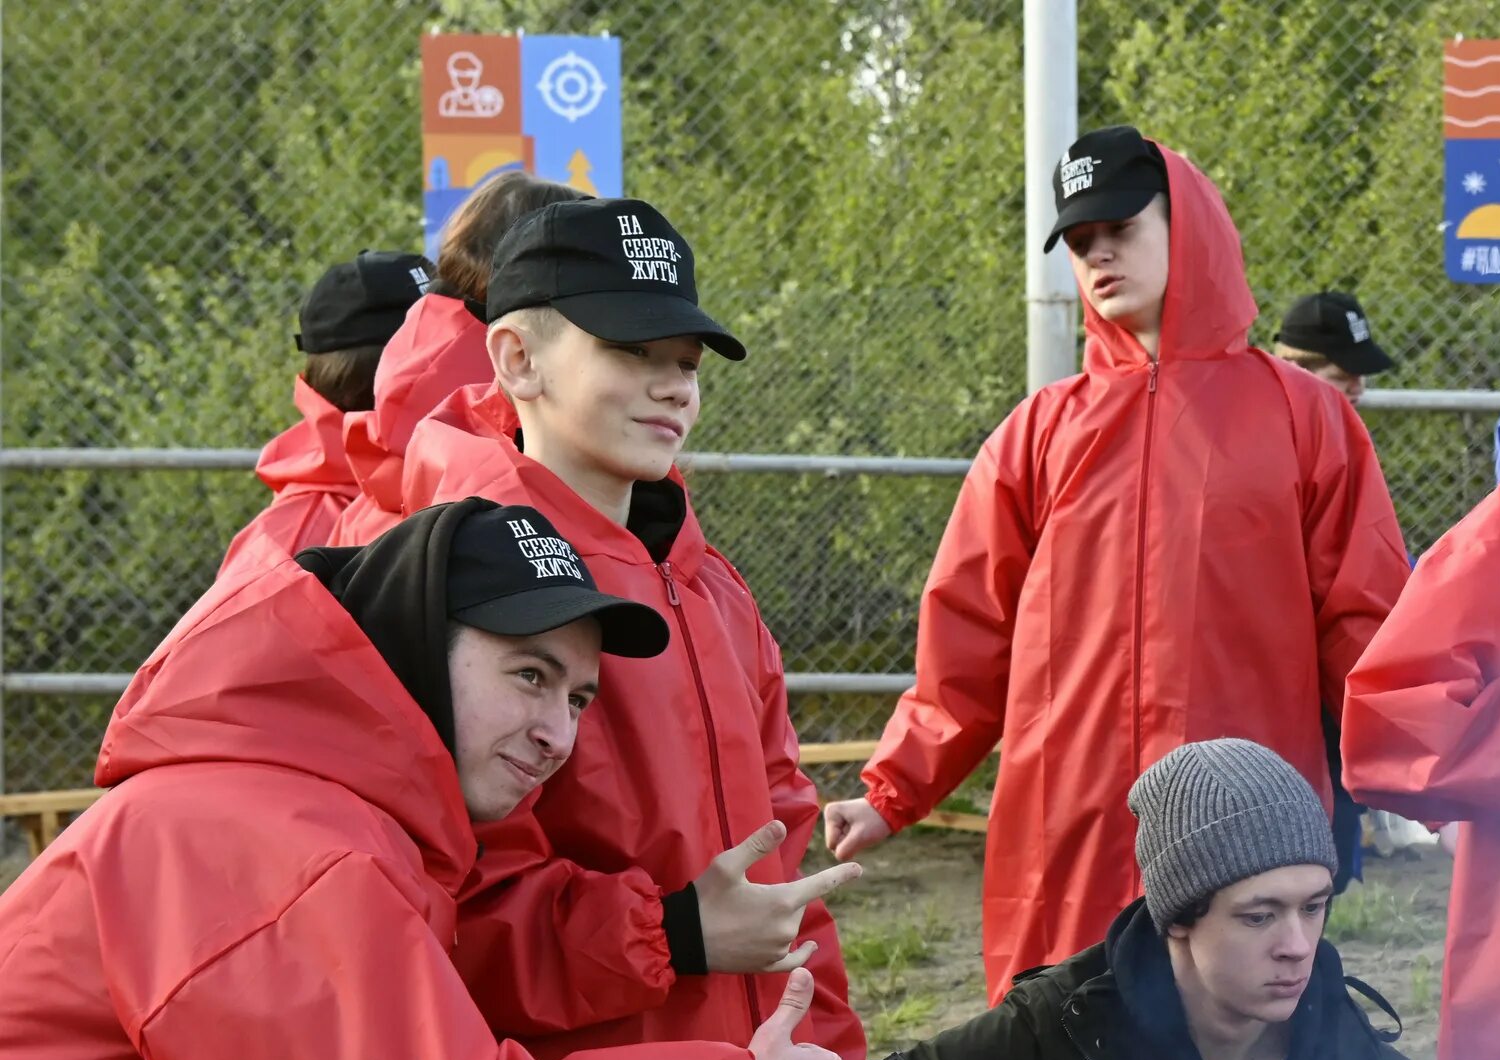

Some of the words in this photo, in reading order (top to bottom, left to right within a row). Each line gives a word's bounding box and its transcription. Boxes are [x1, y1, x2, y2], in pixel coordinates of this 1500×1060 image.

[617, 215, 644, 235] НА
[628, 260, 679, 285] ЖИТЬ!
[506, 519, 538, 538] НА
